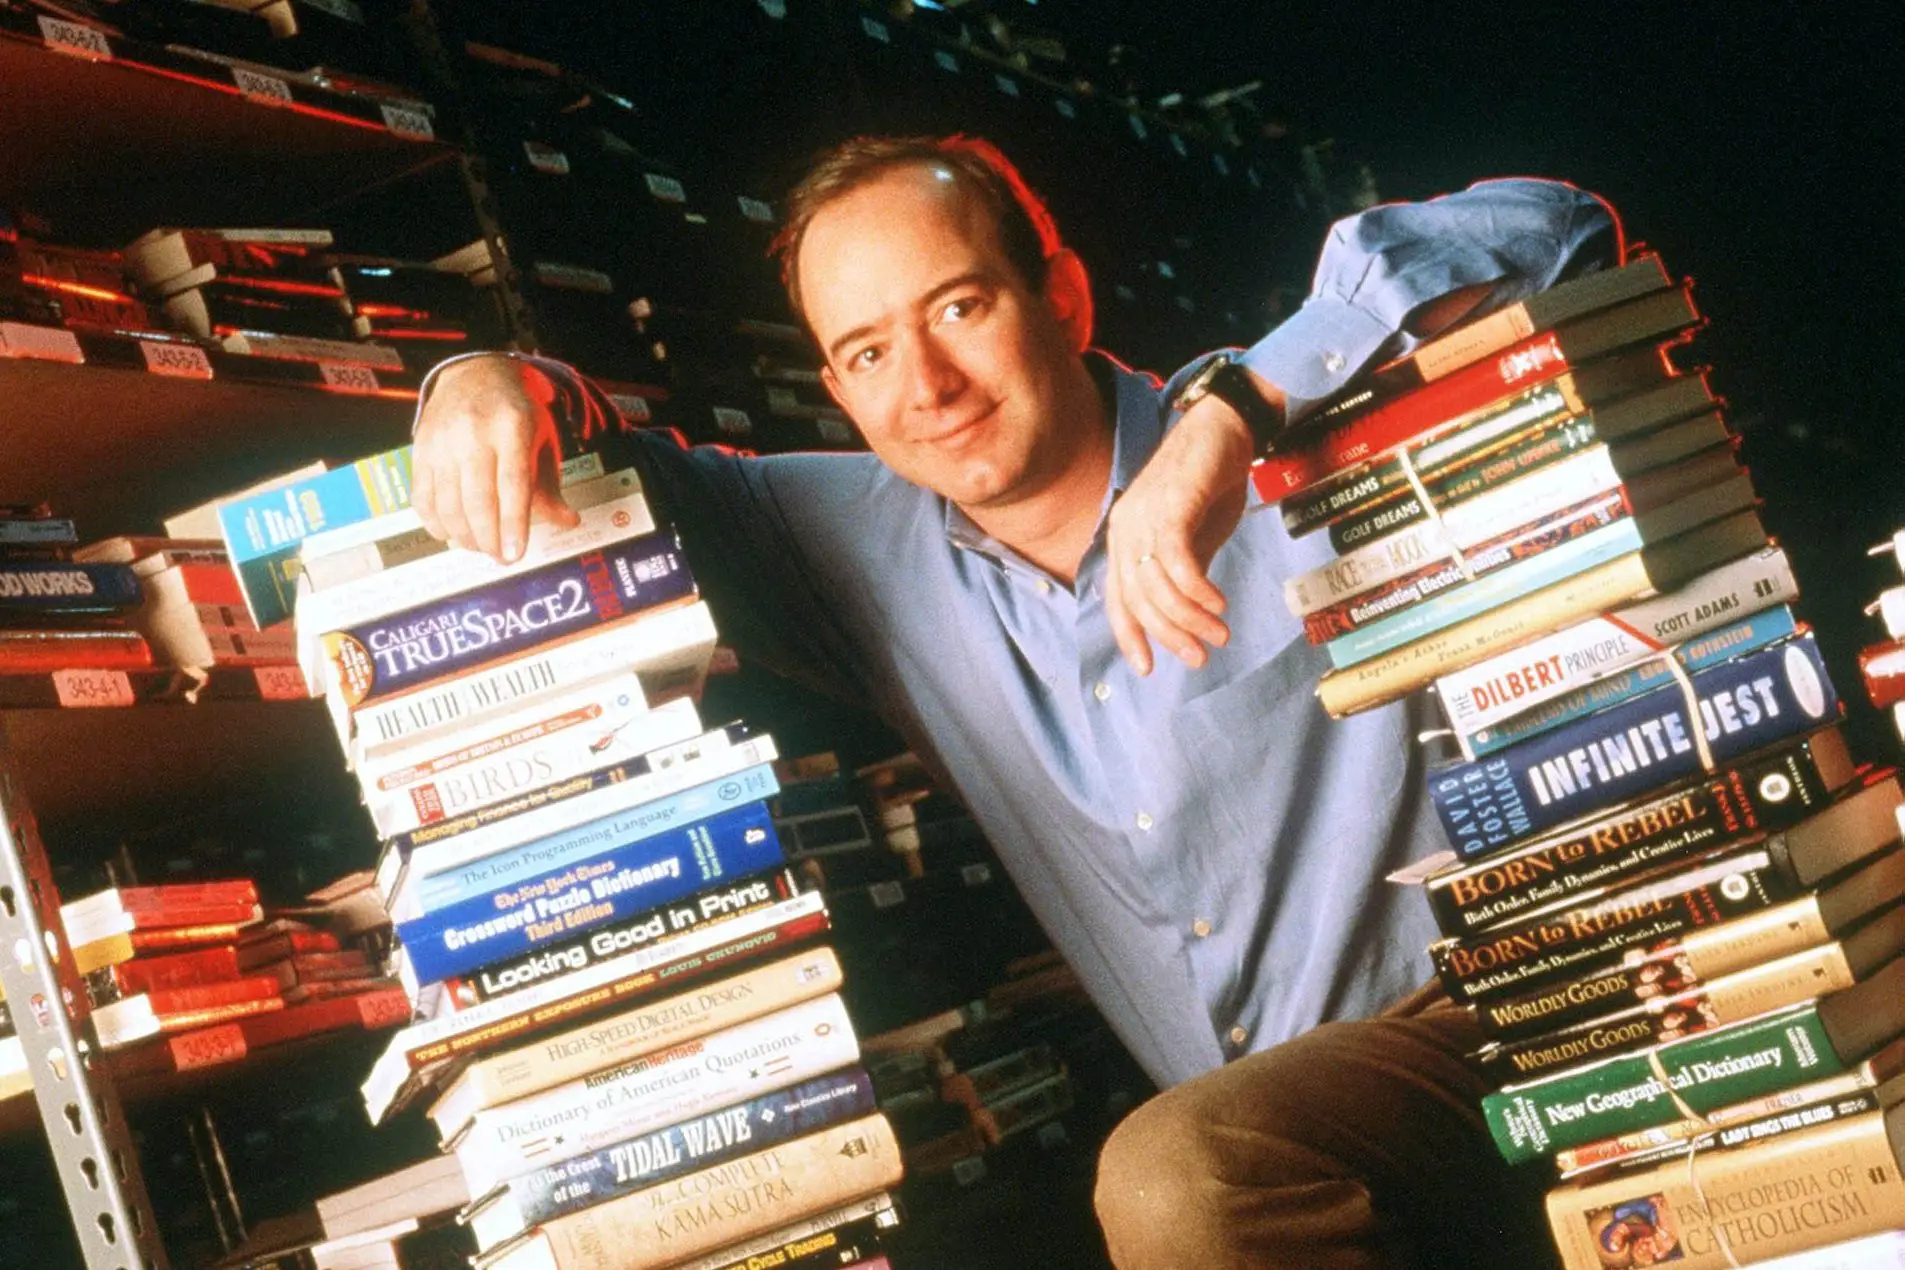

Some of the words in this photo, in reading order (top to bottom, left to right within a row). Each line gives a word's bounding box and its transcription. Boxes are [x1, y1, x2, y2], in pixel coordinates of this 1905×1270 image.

[1327, 476, 1382, 509] DREAMS
[1339, 519, 1374, 544] GOLF
[1371, 499, 1422, 531] DREAMS
[25, 570, 95, 598] WORKS
[1323, 560, 1364, 597] RACE
[1348, 582, 1423, 625] Reinventing
[366, 605, 460, 653] CALIGARI
[1436, 640, 1474, 663] Frank
[1468, 654, 1569, 713] DILBERT
[1563, 633, 1632, 676] PRINCIPLE
[1653, 612, 1694, 638] SCOTT
[1692, 592, 1743, 623] ADAMS
[66, 678, 123, 700] 343-4-1
[374, 689, 461, 740] HEALTH
[469, 657, 557, 710] WEALTH
[1450, 691, 1475, 721] THE
[1523, 709, 1696, 805] INFINITE
[1696, 674, 1784, 740] JEST
[442, 747, 556, 810] BIRDS
[1461, 766, 1507, 845] FOSTER
[1486, 758, 1534, 836] WALLACE
[462, 865, 490, 886] The
[489, 854, 522, 876] Icon
[520, 823, 613, 867] Programming
[611, 801, 679, 837] Language
[1438, 777, 1484, 855] DAVID
[1448, 849, 1558, 908] BORN
[1555, 837, 1588, 865] to
[1586, 791, 1711, 856] REBEL
[1463, 904, 1494, 926] Birth
[1528, 879, 1567, 904] Family
[1616, 850, 1641, 869] and
[1638, 835, 1686, 861] Creative
[1684, 823, 1716, 844] Lives
[441, 903, 538, 952] Crossword
[534, 885, 594, 920] Puzzle
[590, 853, 684, 903] Dictionary
[525, 916, 565, 942] Third
[563, 899, 616, 929] Edition
[1448, 928, 1542, 980] BORN
[1540, 925, 1567, 947] to
[1567, 890, 1677, 943] REBEL
[480, 942, 590, 998] Looking
[589, 913, 668, 957] Good
[667, 902, 700, 930] in
[698, 878, 772, 920] Print
[1462, 977, 1491, 998] Birth
[1653, 915, 1684, 935] Lives
[414, 1042, 451, 1064] THE
[450, 1015, 532, 1051] NORTHERN
[532, 987, 613, 1023] EXPOSURE
[613, 971, 658, 995] BOOK
[544, 1017, 641, 1064] HIGH-SPEED
[636, 998, 699, 1033] DIGITAL
[696, 979, 756, 1012] DESIGN
[1489, 986, 1570, 1030] WORLDLY
[1566, 968, 1631, 1006] GOODS
[582, 1057, 651, 1092] American
[646, 1038, 706, 1071] Heritage
[1512, 1034, 1591, 1074] WORLDLY
[1587, 1015, 1653, 1051] GOODS
[495, 1098, 594, 1146] Dictionary
[591, 1086, 618, 1112] of
[615, 1061, 704, 1104] American
[702, 1027, 805, 1077] Quotations
[1544, 1097, 1587, 1128] New
[1584, 1064, 1696, 1117] Geographcal
[1692, 1037, 1785, 1088] Dictionary
[607, 1129, 686, 1183] TIDAL
[679, 1105, 755, 1158] WAVE
[1720, 1125, 1750, 1146] LADY
[1779, 1111, 1802, 1130] THE
[1800, 1101, 1835, 1125] BLUES
[542, 1165, 568, 1186] the
[564, 1152, 602, 1178] Crest
[551, 1185, 570, 1204] of
[566, 1177, 592, 1198] the
[675, 1148, 787, 1202] COMPLETE
[1825, 1163, 1857, 1192] OF
[655, 1200, 722, 1242] KAMA
[722, 1175, 796, 1219] SUTRA
[1683, 1186, 1869, 1260] CATHOLICISM
[785, 1232, 838, 1261] TRADING
